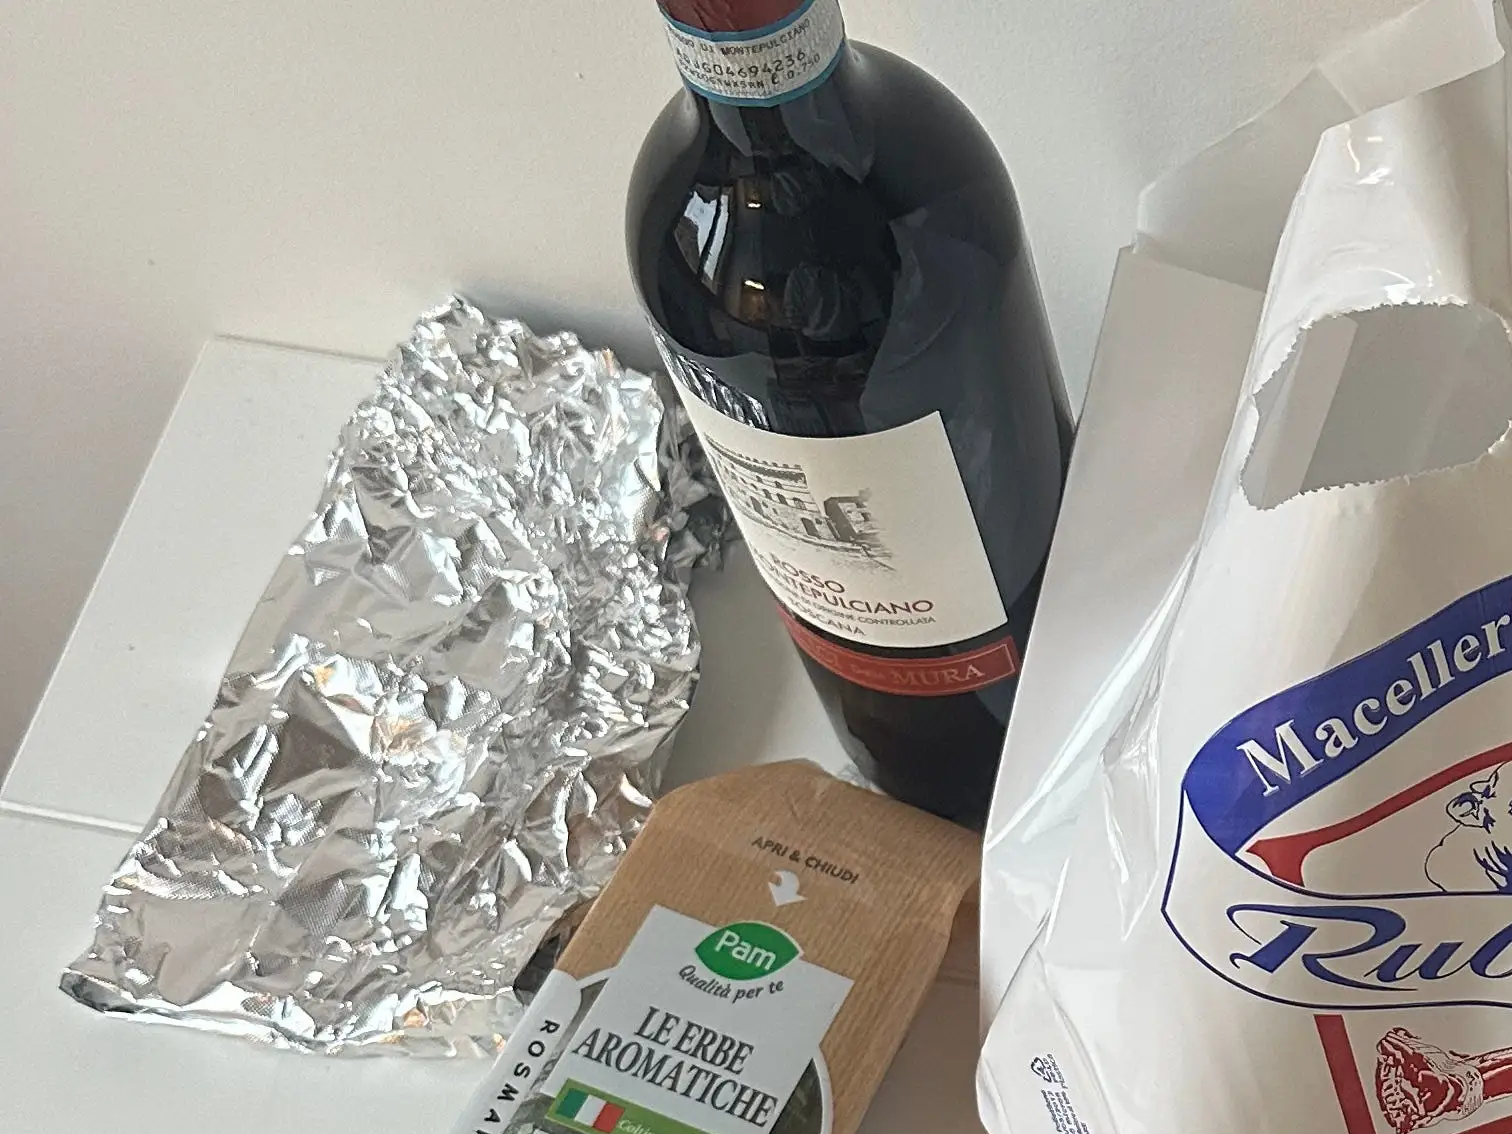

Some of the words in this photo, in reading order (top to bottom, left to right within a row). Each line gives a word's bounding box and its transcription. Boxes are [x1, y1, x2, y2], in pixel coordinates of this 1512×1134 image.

[857, 615, 936, 627] CONTROLLATA
[751, 834, 789, 861] APRI
[788, 848, 802, 863] &
[804, 853, 860, 886] CHIUDI
[715, 930, 778, 972] Pam
[678, 964, 732, 999] Qualità
[734, 984, 765, 1004] per
[768, 979, 785, 995] te
[634, 1006, 677, 1045] LE
[681, 1019, 754, 1076] ERBE
[571, 1027, 779, 1129] AROMATICHE
